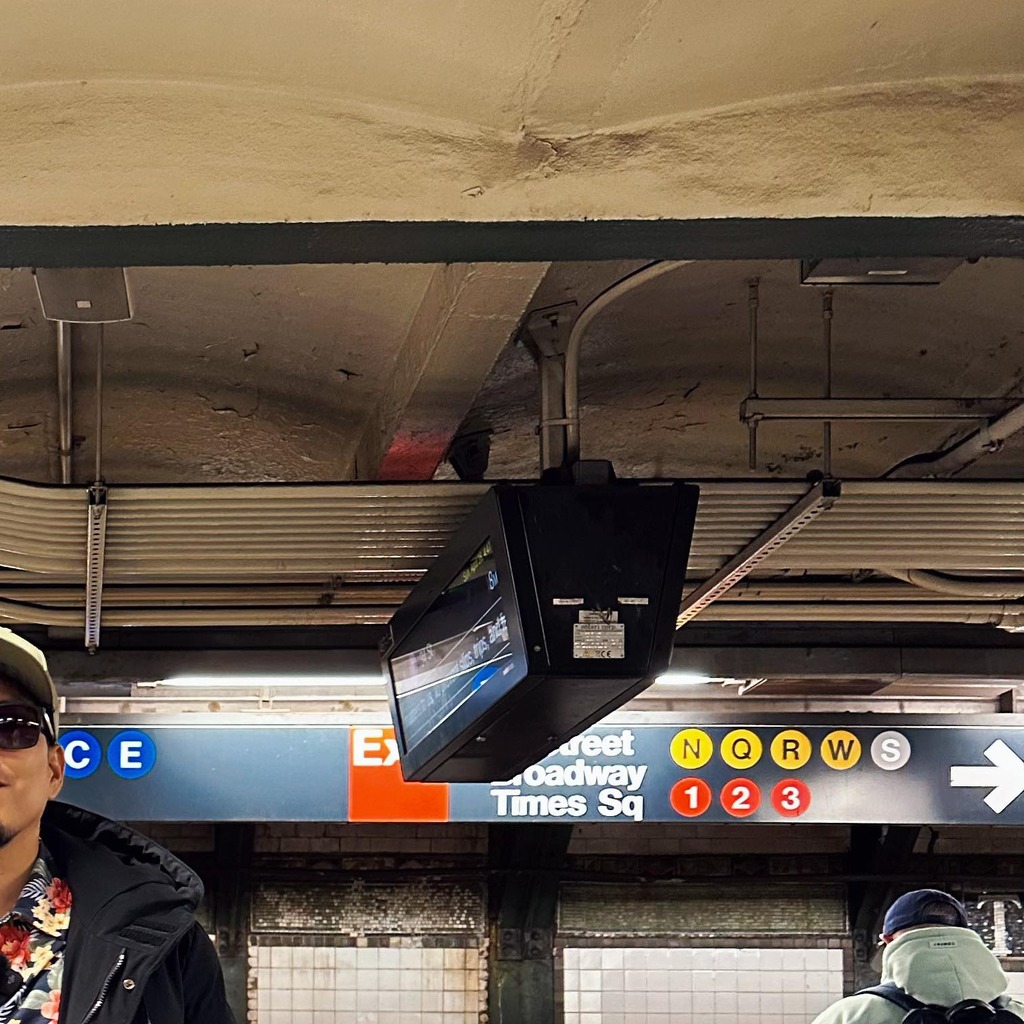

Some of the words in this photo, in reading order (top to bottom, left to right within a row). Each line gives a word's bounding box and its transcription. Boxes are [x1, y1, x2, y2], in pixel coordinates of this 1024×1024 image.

[64, 740, 90, 769] C
[119, 741, 142, 769] E
[353, 729, 400, 766] Ex
[546, 730, 635, 756] treet
[682, 738, 701, 760] N
[731, 737, 752, 760] Q
[781, 738, 801, 761] R
[827, 738, 855, 761] W
[880, 738, 901, 763] S
[491, 758, 647, 791] oadway
[490, 788, 588, 817] Times
[597, 788, 644, 822] Sq
[684, 785, 698, 809] 1
[731, 785, 751, 810] 2
[781, 786, 801, 810] 3
